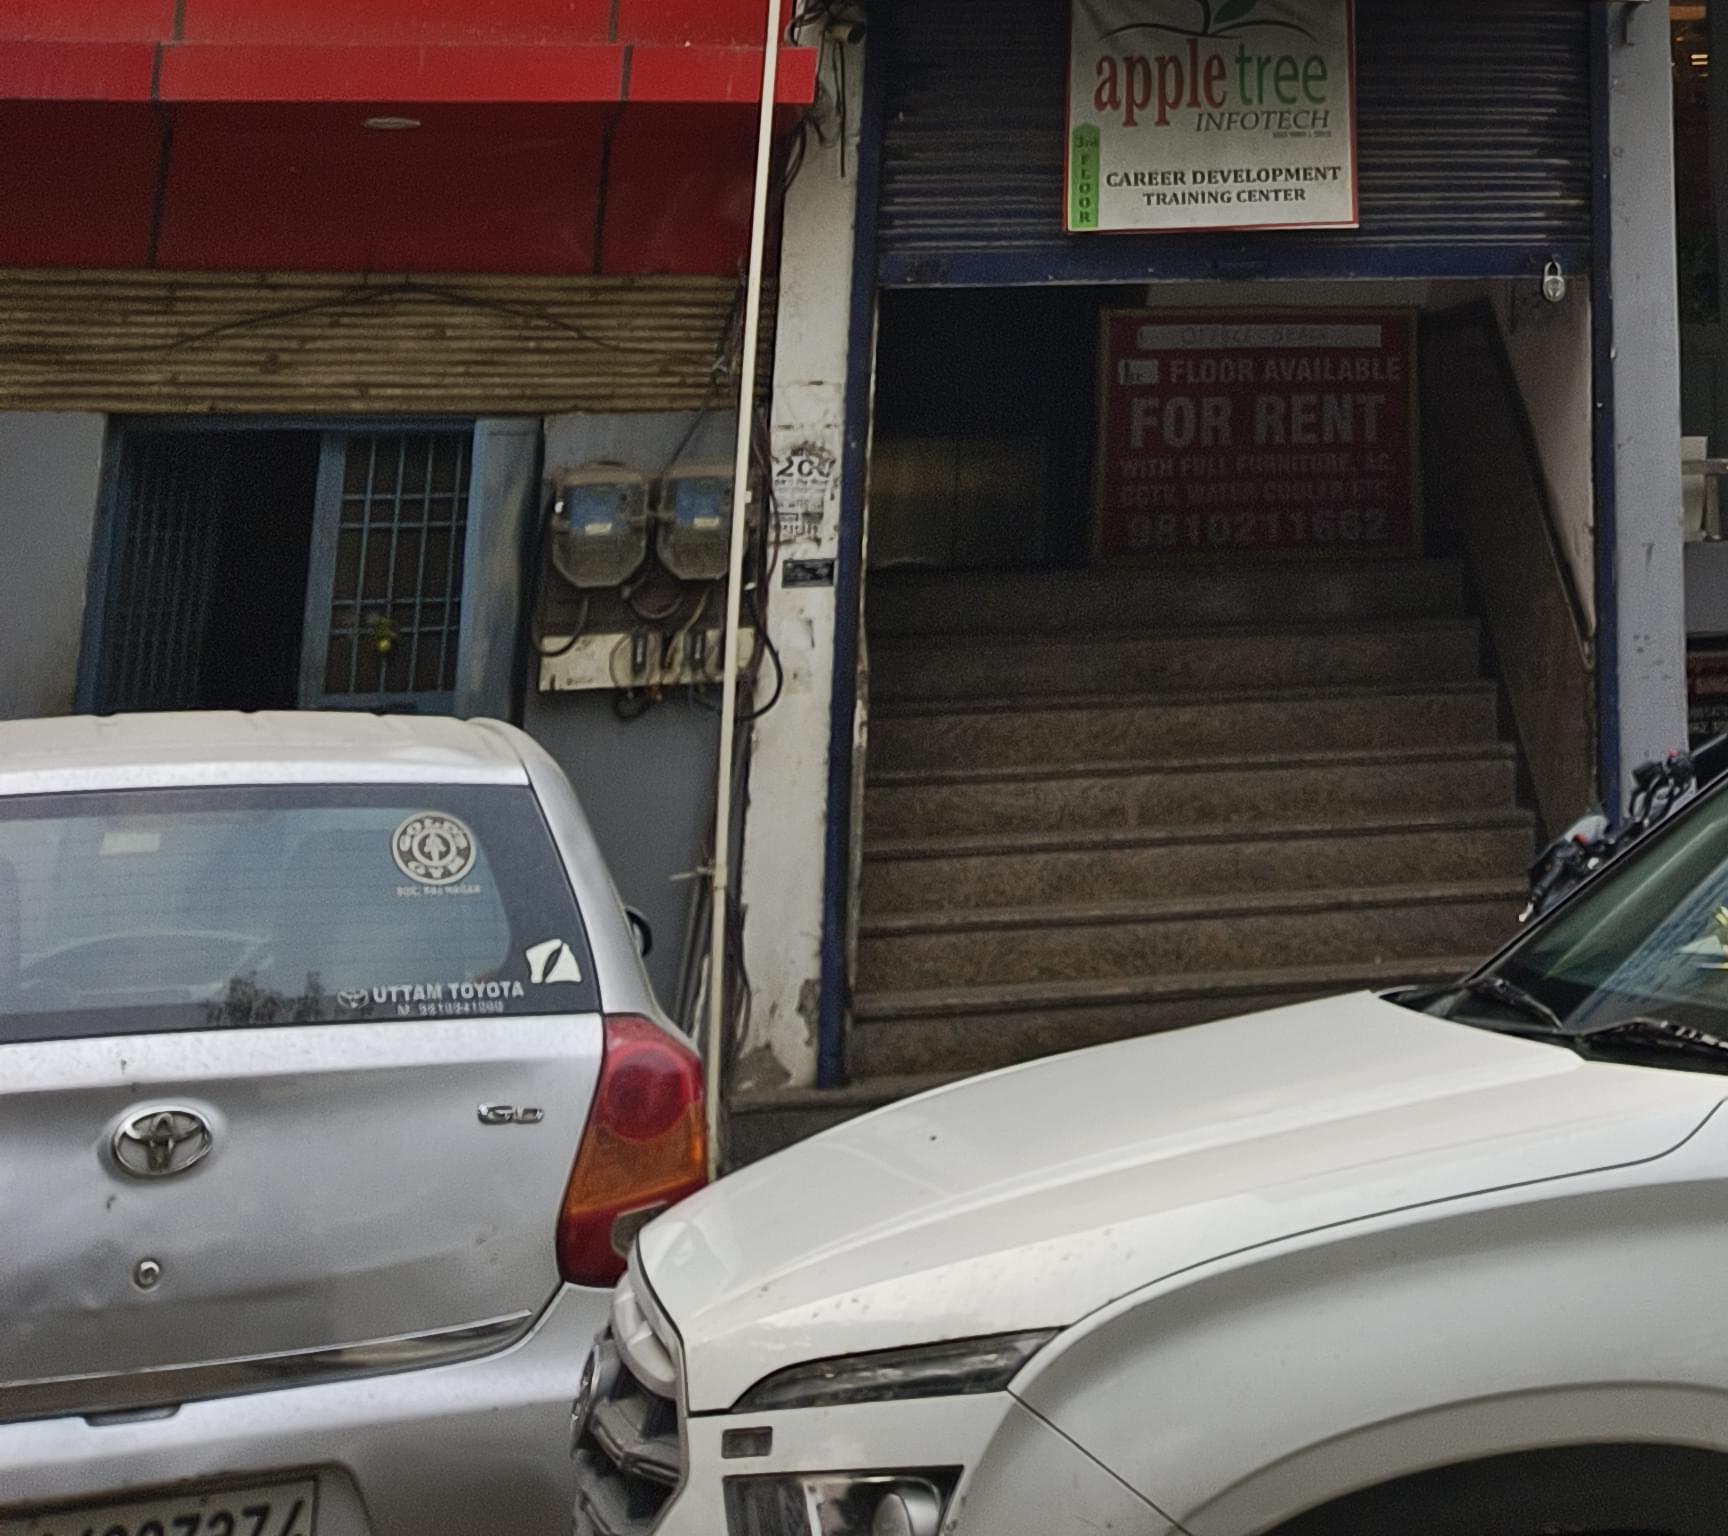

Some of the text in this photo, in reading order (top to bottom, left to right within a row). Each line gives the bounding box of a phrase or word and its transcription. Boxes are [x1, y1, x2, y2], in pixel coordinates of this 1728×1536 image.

[1094, 37, 1327, 127] apple tree
[1196, 110, 1329, 132] INFOTECH
[1078, 154, 1091, 223] FLOOR
[1106, 166, 1341, 187] CAREER DEVELOPMENT
[1143, 188, 1306, 206] TRAINING CENTER
[1170, 359, 1254, 384] FLOOR
[1264, 356, 1401, 382] AVAILABLE
[1129, 393, 1386, 449] FOR RENT
[373, 980, 524, 1003] UTTAM TOYOTA
